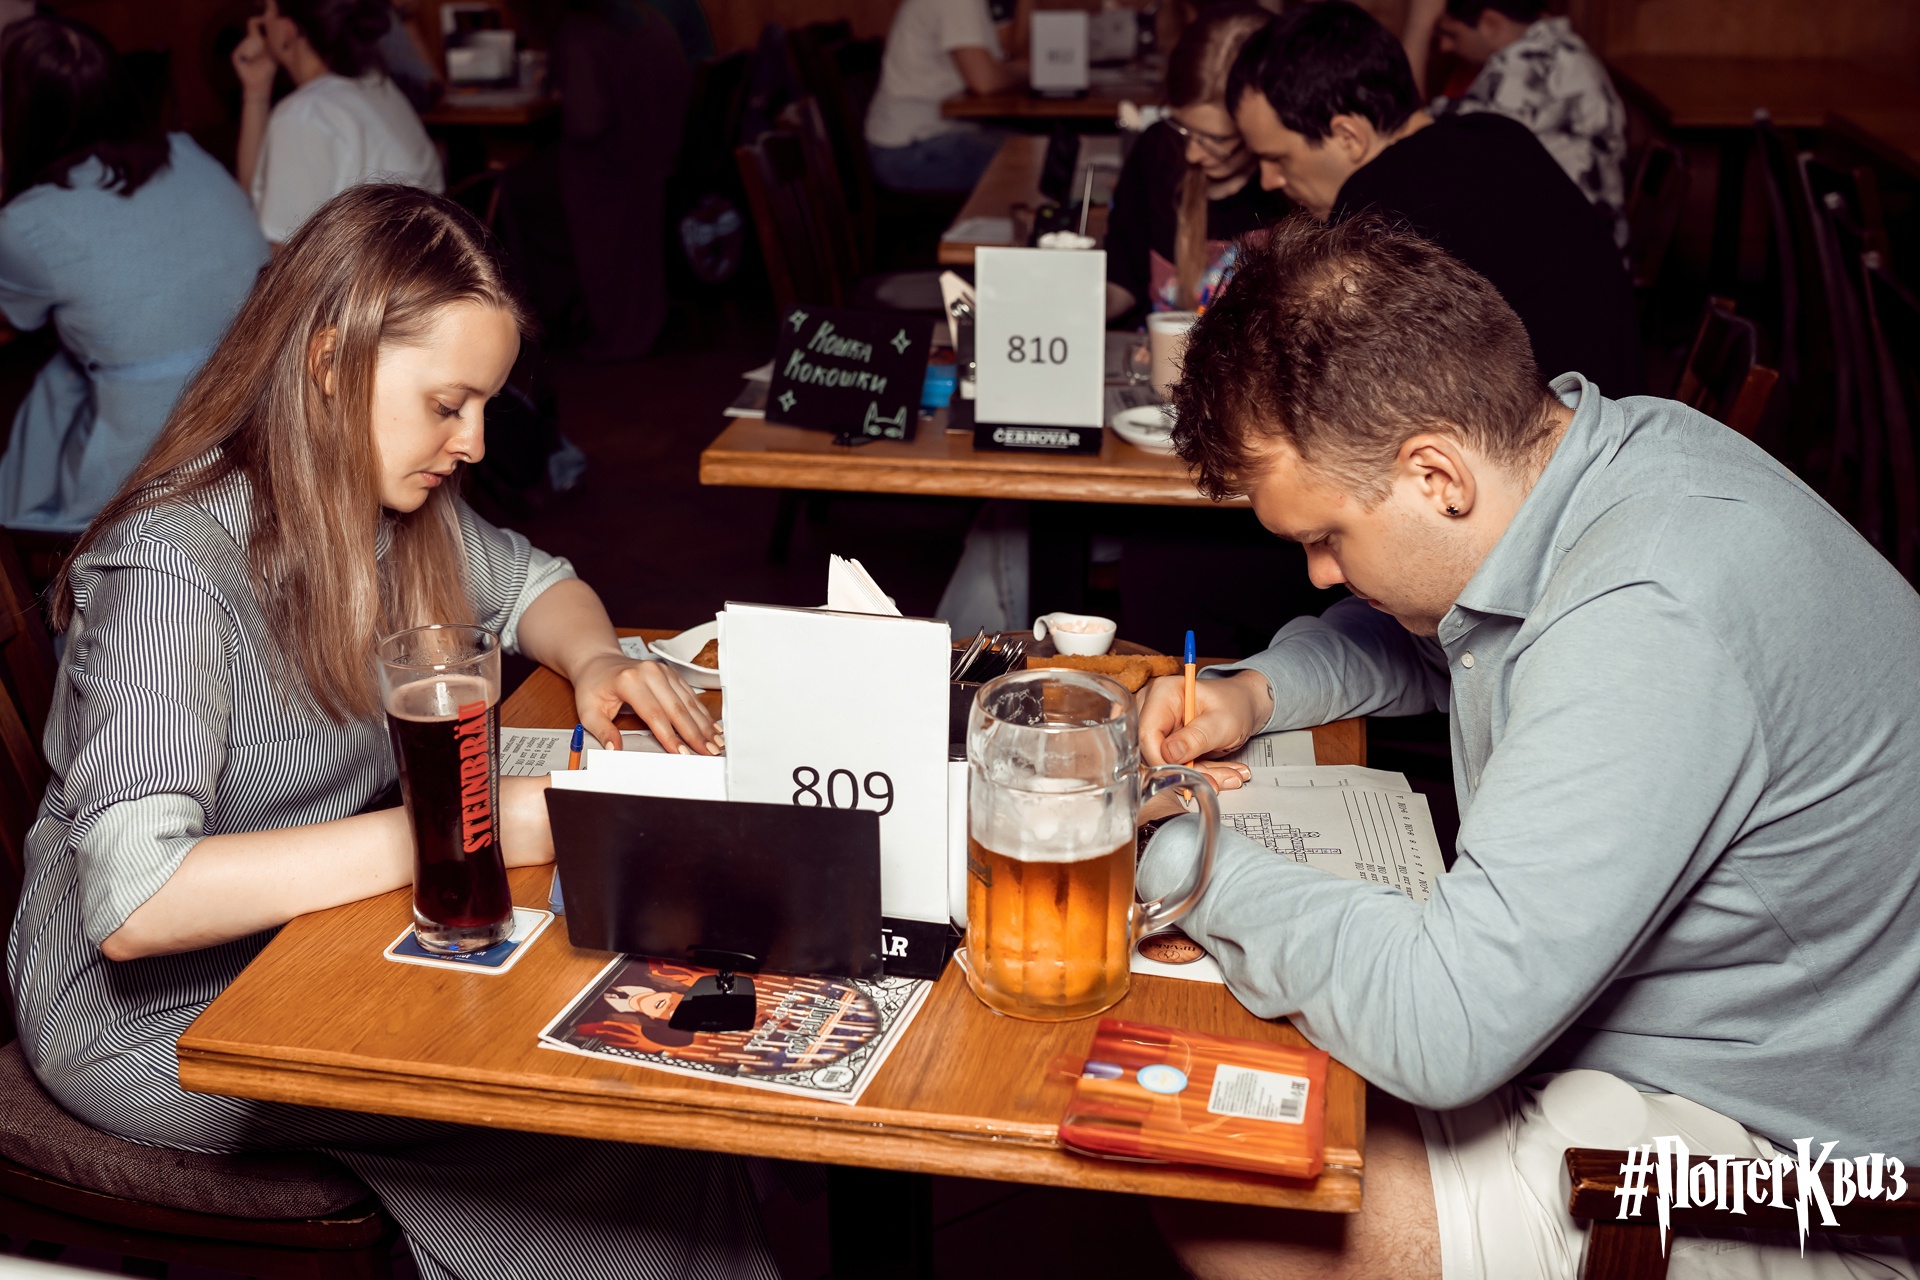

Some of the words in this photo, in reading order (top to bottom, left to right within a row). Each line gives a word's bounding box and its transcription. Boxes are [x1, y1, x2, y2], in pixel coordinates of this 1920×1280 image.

[807, 320, 873, 363] Кошка
[1007, 335, 1068, 365] 810
[783, 348, 887, 394] Кокошки
[454, 700, 493, 853] STEINBRÄU
[792, 766, 894, 816] 809
